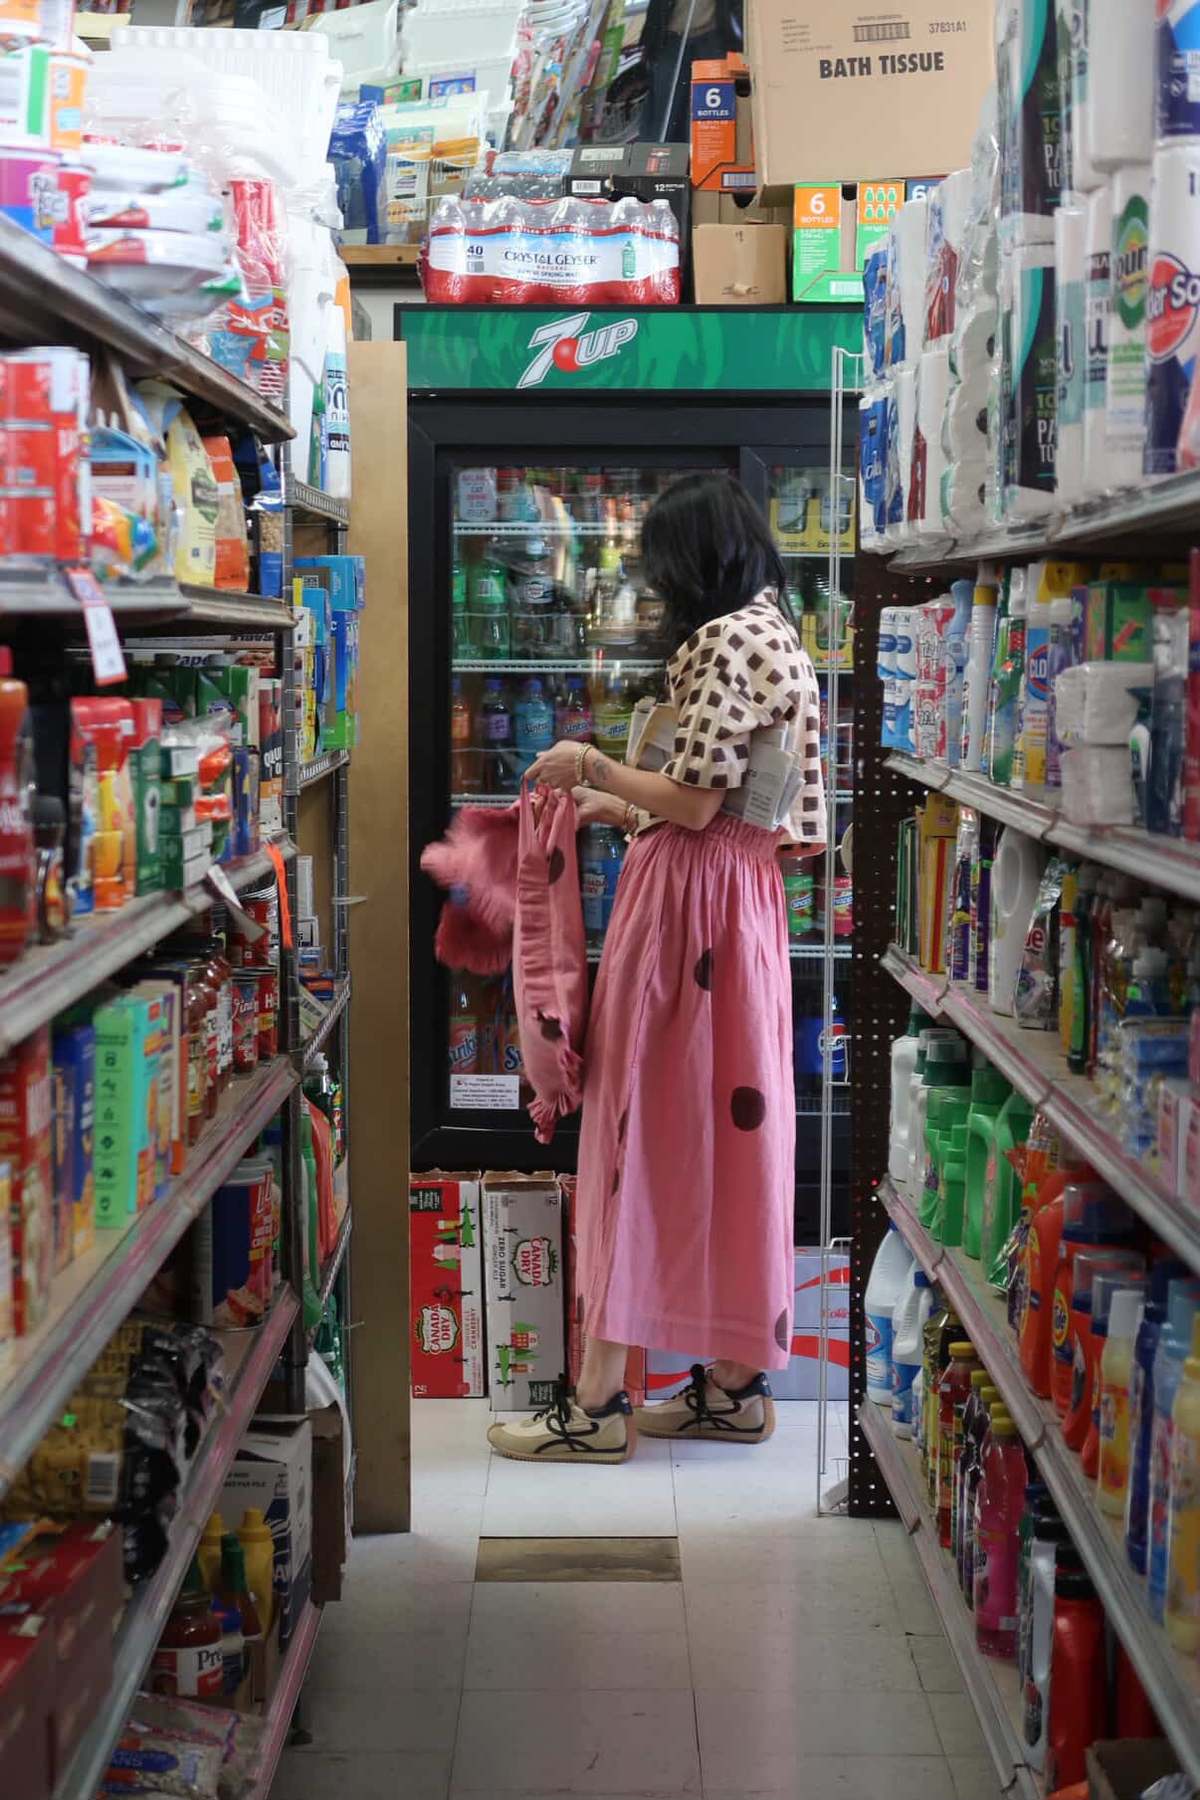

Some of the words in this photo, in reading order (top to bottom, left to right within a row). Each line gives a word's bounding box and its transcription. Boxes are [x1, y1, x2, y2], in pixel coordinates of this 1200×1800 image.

[819, 56, 872, 79] BATH
[878, 52, 944, 75] TISSUE
[705, 87, 721, 108] 6
[697, 109, 729, 117] BOTTLES
[654, 183, 665, 192] 12
[810, 192, 825, 215] 6
[467, 245, 484, 256] 40
[504, 250, 552, 265] CRYSTAL
[555, 252, 598, 265] GEYSER
[1029, 657, 1048, 679] CLO
[520, 1250, 531, 1276] DRY
[531, 1236, 542, 1287] CANADA
[430, 1303, 441, 1355] CANADA
[441, 1315, 451, 1341] DRY
[414, 1384, 424, 1395] 12
